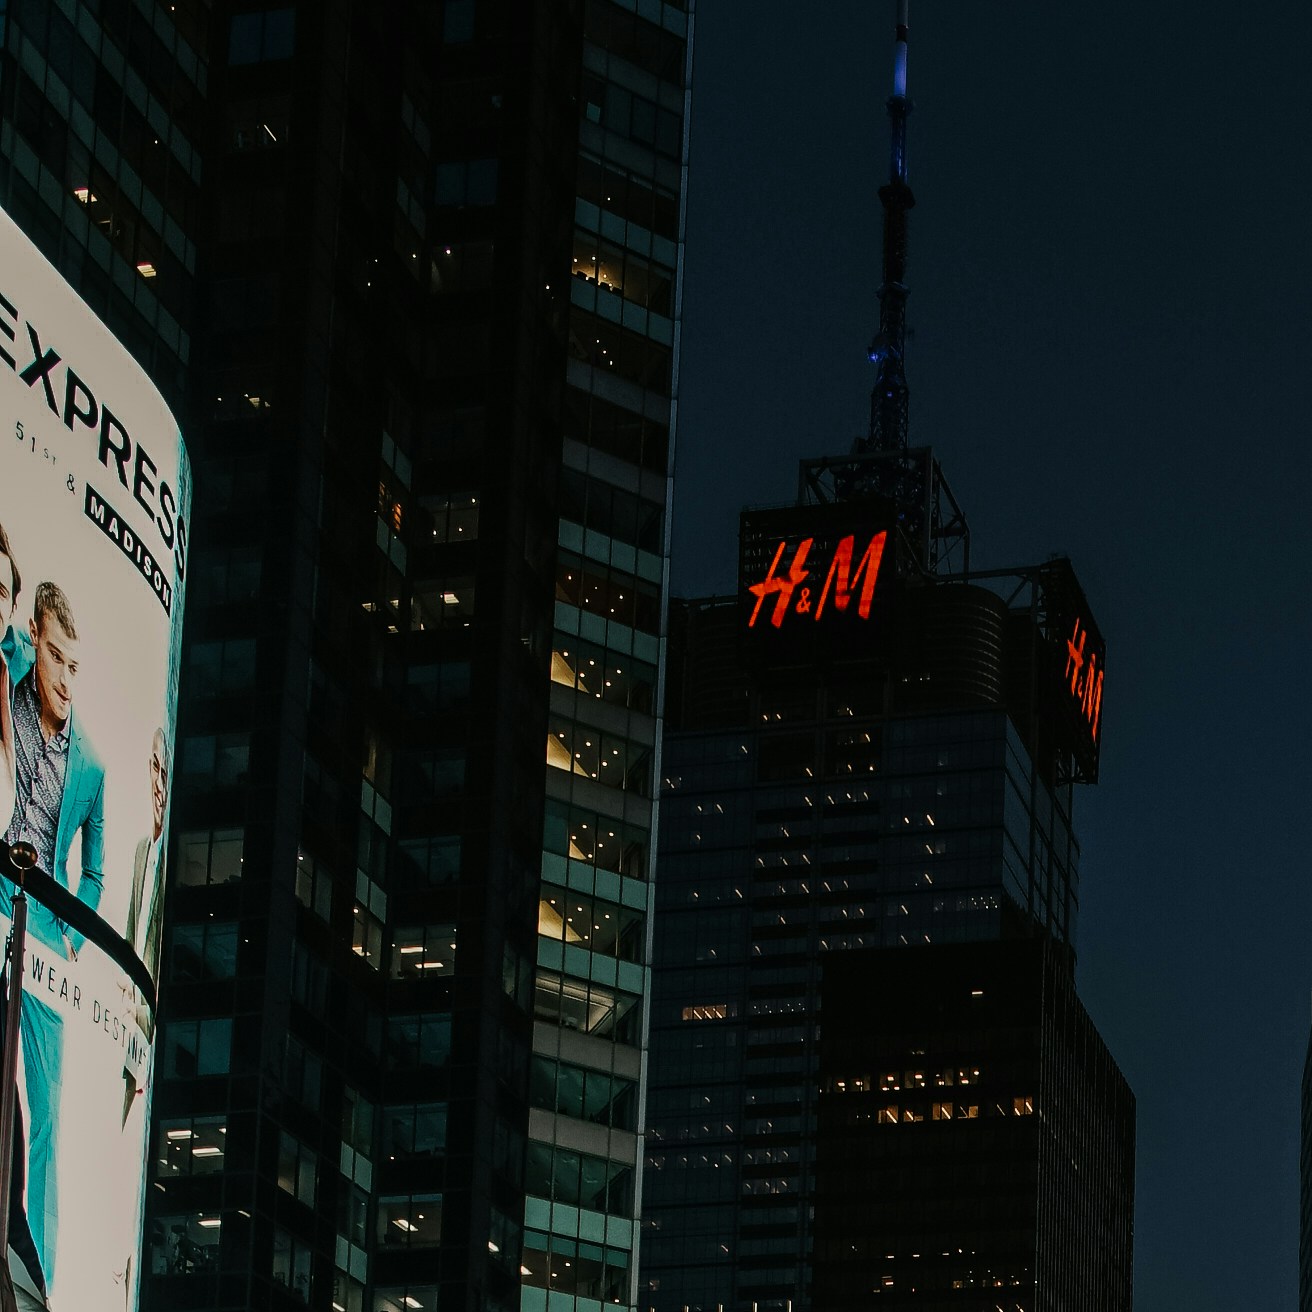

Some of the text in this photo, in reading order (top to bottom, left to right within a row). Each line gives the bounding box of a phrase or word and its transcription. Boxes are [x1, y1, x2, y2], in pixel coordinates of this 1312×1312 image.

[66, 473, 172, 607] & MADISON
[748, 529, 888, 629] H&M
[1065, 617, 1104, 744] H&M
[31, 953, 82, 1011] WEAR
